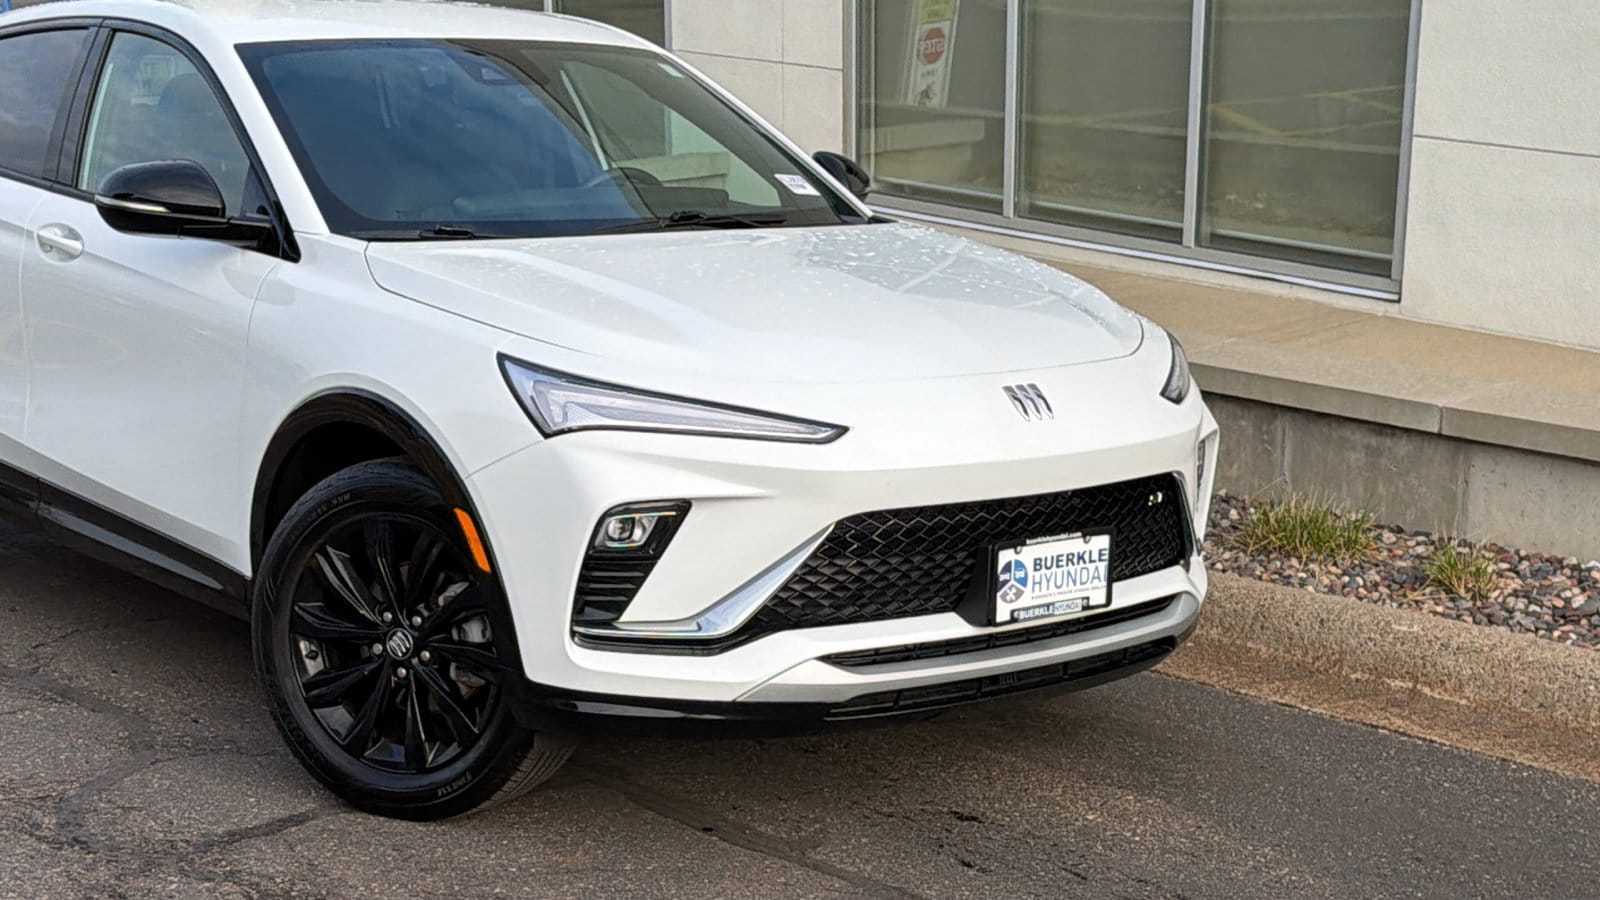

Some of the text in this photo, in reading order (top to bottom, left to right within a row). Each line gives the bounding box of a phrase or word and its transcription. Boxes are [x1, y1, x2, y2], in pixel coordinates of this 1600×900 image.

[1033, 548, 1108, 572] BUERKLE
[1031, 564, 1108, 593] HYUNDAI
[1019, 603, 1054, 619] BUERKLE
